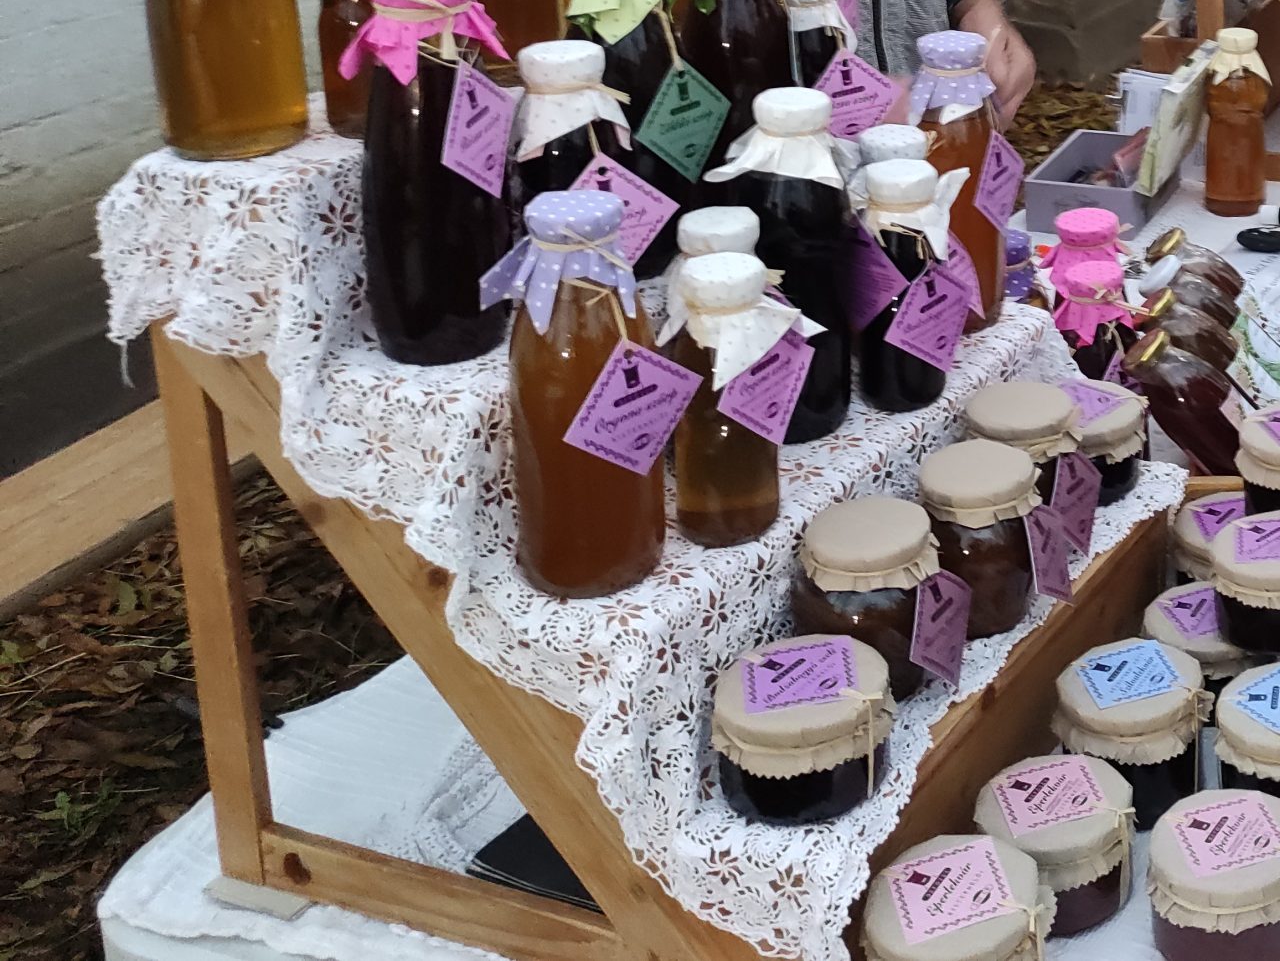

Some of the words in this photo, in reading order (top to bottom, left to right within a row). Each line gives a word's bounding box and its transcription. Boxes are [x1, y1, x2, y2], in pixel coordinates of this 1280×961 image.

[1026, 773, 1069, 814] Eperlekvár
[1209, 812, 1246, 856] Eperlekvár
[926, 862, 973, 916] Eperlekvár
